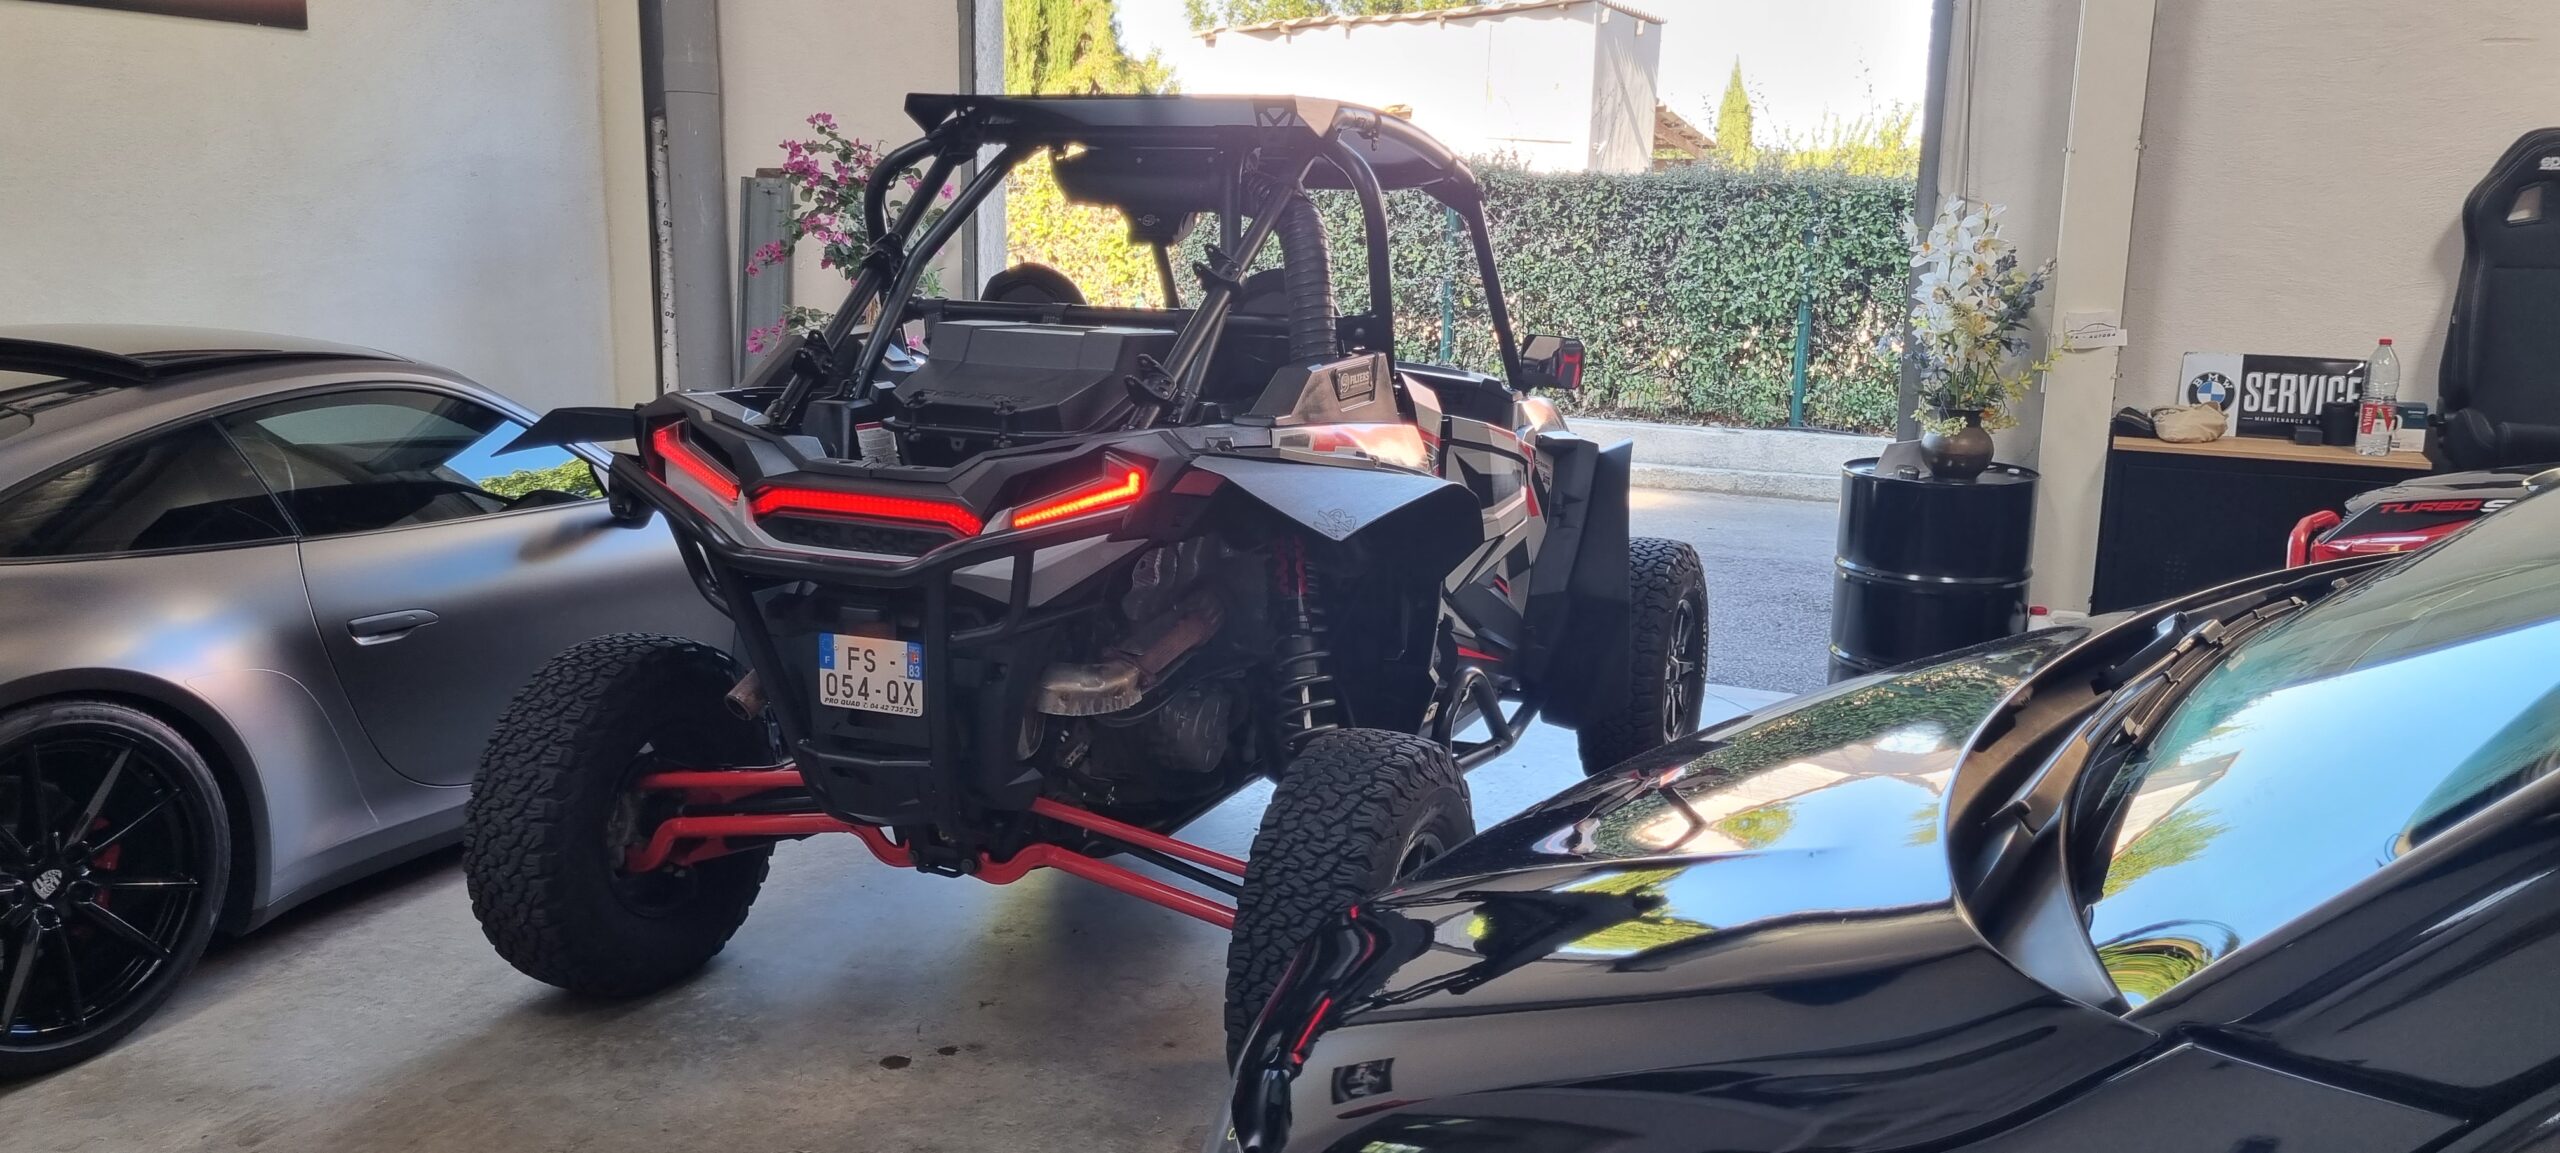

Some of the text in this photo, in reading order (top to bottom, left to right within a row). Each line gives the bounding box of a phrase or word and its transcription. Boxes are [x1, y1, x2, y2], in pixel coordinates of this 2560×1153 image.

[2193, 373, 2234, 389] BMW
[2254, 416, 2303, 424] MAINTENANCE
[2380, 500, 2481, 514] TURBO
[824, 655, 831, 664] F
[847, 646, 876, 673] FS
[908, 664, 920, 678] 83
[826, 672, 915, 707] 054-QX
[824, 697, 839, 705] PRO
[840, 699, 861, 707] QUAD
